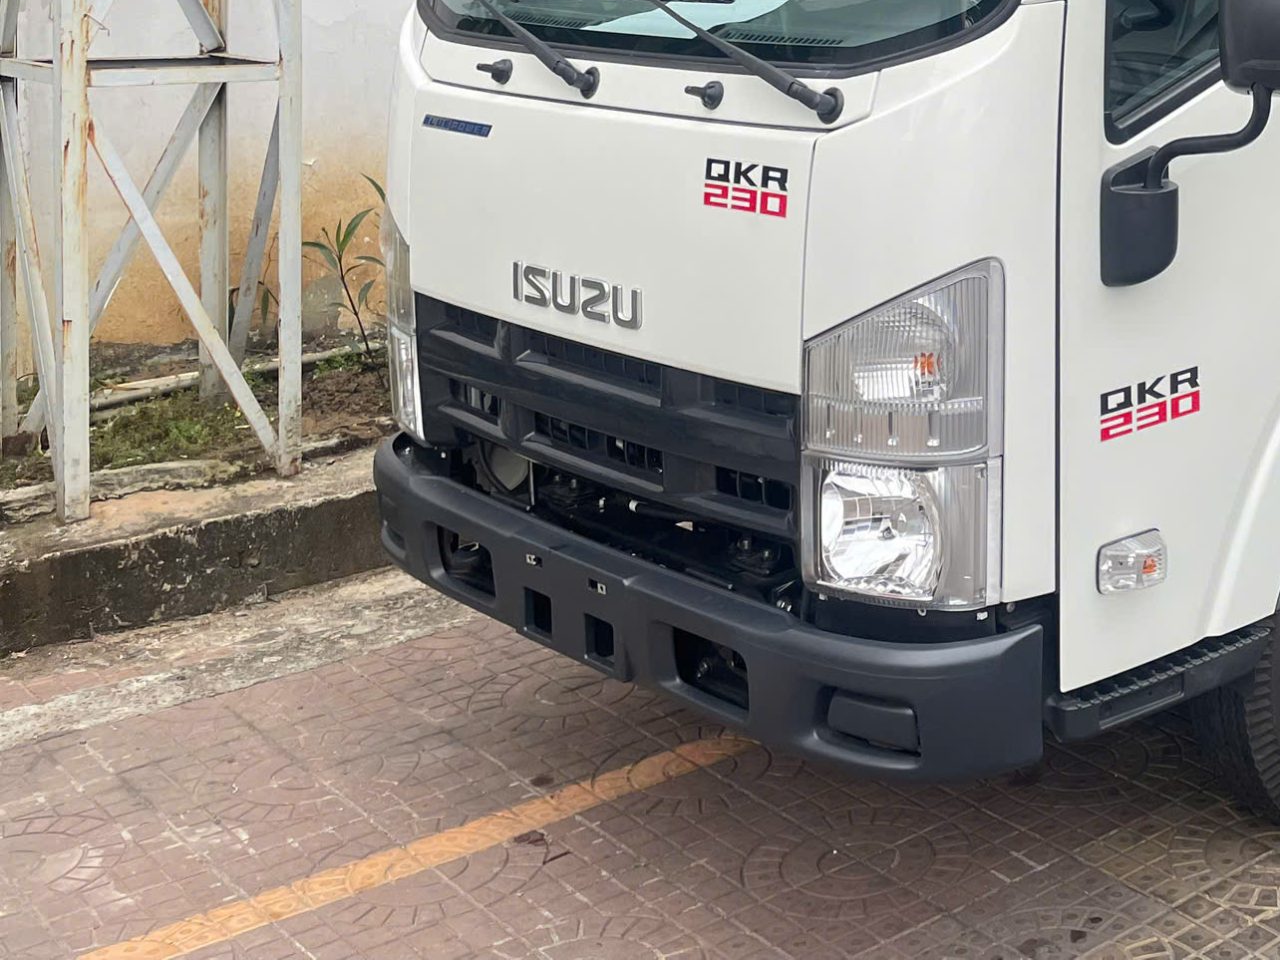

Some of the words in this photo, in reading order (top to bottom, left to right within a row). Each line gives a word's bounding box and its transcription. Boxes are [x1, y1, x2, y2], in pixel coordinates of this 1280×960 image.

[704, 158, 789, 192] QKR
[703, 183, 788, 219] 230
[512, 260, 643, 331] ISUZU
[1100, 366, 1200, 417] QKR
[1100, 390, 1200, 442] 230
